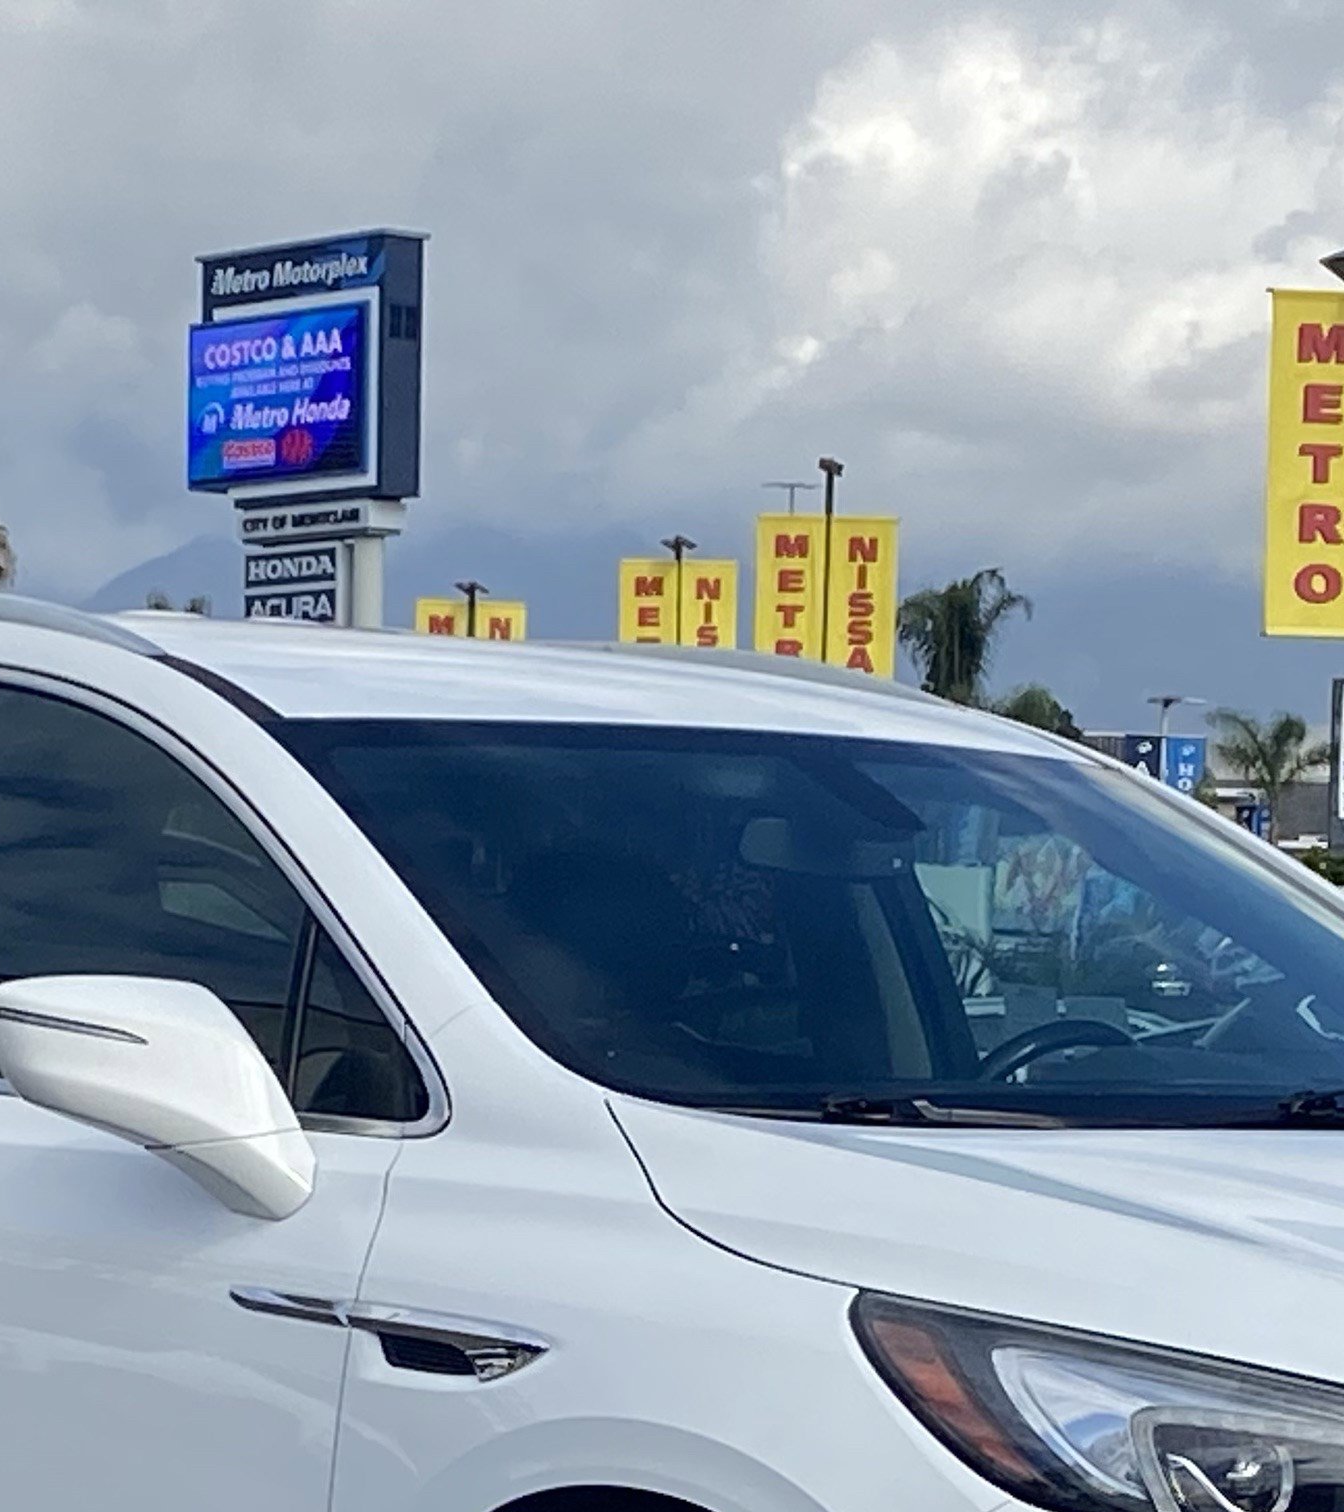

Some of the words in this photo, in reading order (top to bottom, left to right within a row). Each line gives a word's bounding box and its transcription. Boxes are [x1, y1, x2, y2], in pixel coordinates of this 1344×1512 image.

[211, 267, 270, 295] Metro
[272, 252, 368, 286] Motorplex
[204, 336, 277, 370] COSTCO
[281, 333, 296, 359] &
[299, 327, 343, 358] AAA
[229, 403, 289, 430] Metro
[291, 393, 351, 427] Honda
[271, 514, 288, 530] OF
[247, 554, 335, 582] HONDA
[250, 593, 333, 620] ACURA
[634, 576, 664, 643] ME
